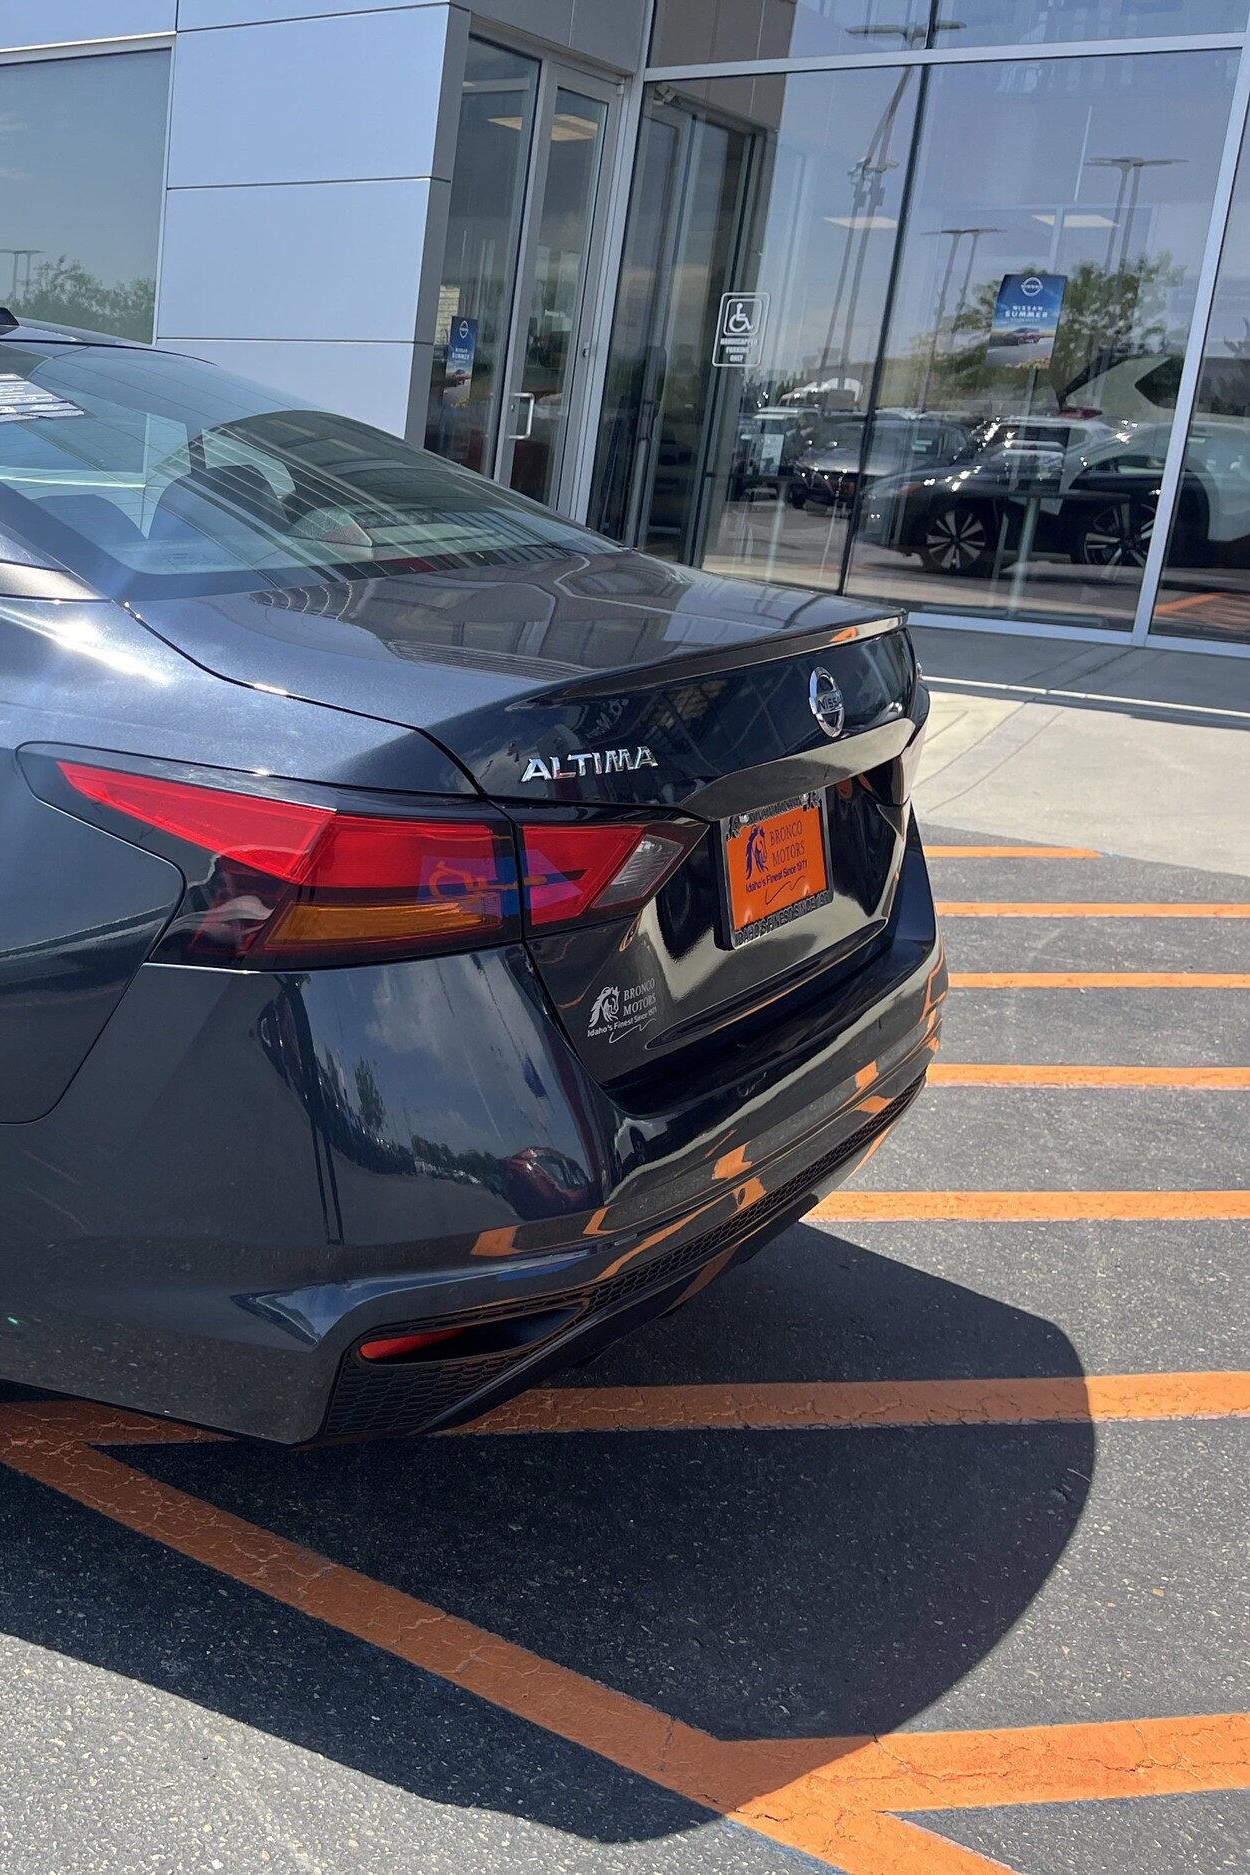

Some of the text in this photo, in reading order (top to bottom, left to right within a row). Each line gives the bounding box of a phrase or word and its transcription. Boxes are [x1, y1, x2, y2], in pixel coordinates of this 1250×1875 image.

[1005, 310, 1048, 319] SUMMER
[521, 746, 658, 782] ALTIMA
[769, 821, 803, 846] BRONCO
[772, 840, 805, 867] MOTORS
[745, 878, 766, 893] Idaho's
[766, 871, 783, 885] Finest
[623, 978, 655, 1001] BRONCO
[623, 992, 656, 1017] MOTORS
[587, 1025, 613, 1037] Idaho's
[614, 1018, 634, 1029] Finest
[634, 1012, 647, 1023] Since
